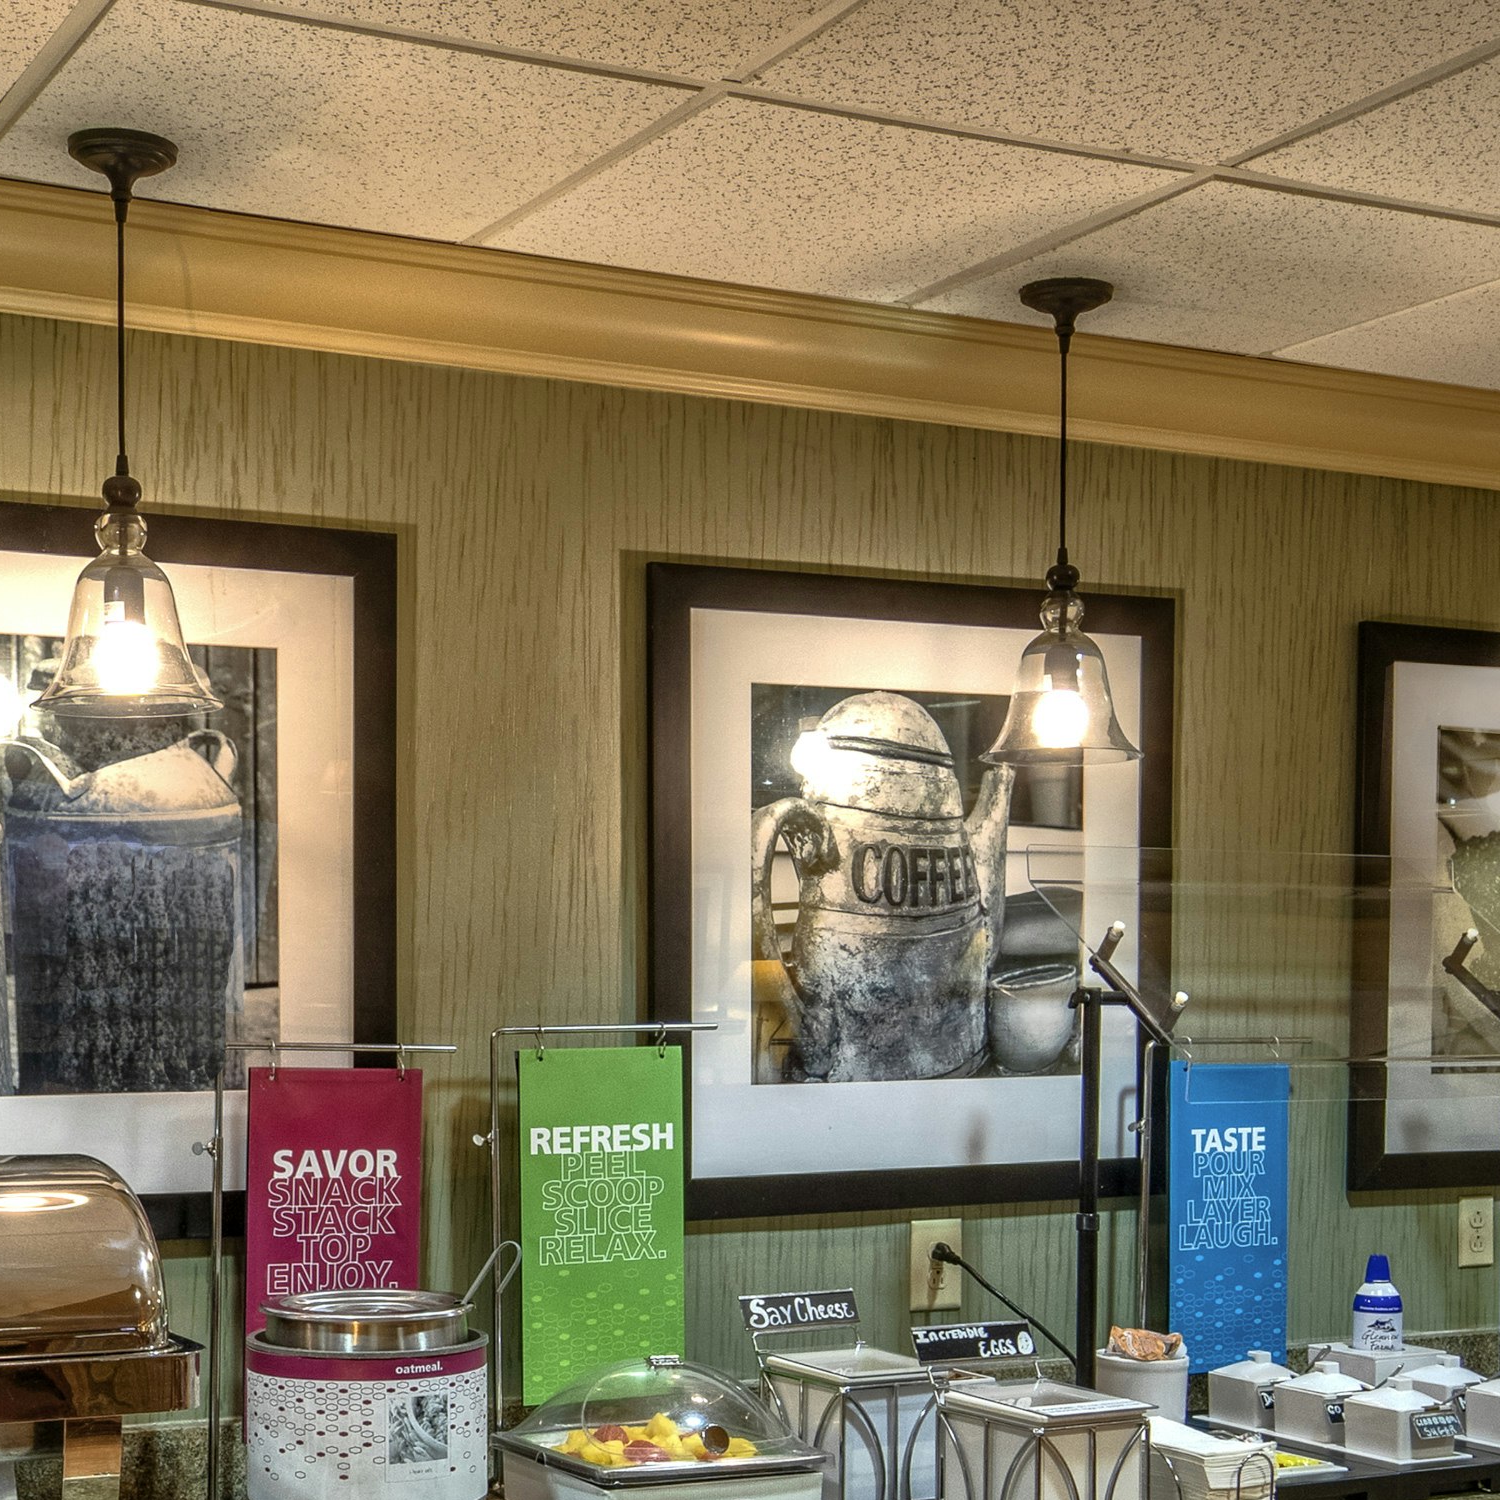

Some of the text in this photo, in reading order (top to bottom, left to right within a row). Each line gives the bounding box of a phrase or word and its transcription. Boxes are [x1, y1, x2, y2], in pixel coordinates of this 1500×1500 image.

[852, 843, 975, 907] COFFEE
[530, 1123, 673, 1155] REFRESH
[1191, 1127, 1266, 1153] TASTE
[273, 1149, 398, 1178] SAVOR
[561, 1151, 646, 1181] PEEL
[1193, 1150, 1265, 1178] POUR
[268, 1175, 402, 1208] SNACK
[542, 1176, 664, 1211] SCOOP
[1203, 1173, 1256, 1201] MIX
[273, 1204, 396, 1237] STACK
[555, 1204, 653, 1237] SLICE
[1187, 1196, 1271, 1226] LAYER
[297, 1233, 372, 1265] TOP
[540, 1230, 667, 1266] RELAX.
[1179, 1220, 1278, 1251] LAUGH.
[267, 1260, 398, 1295] ENJOY.
[395, 1361, 443, 1375] oatmeal.
